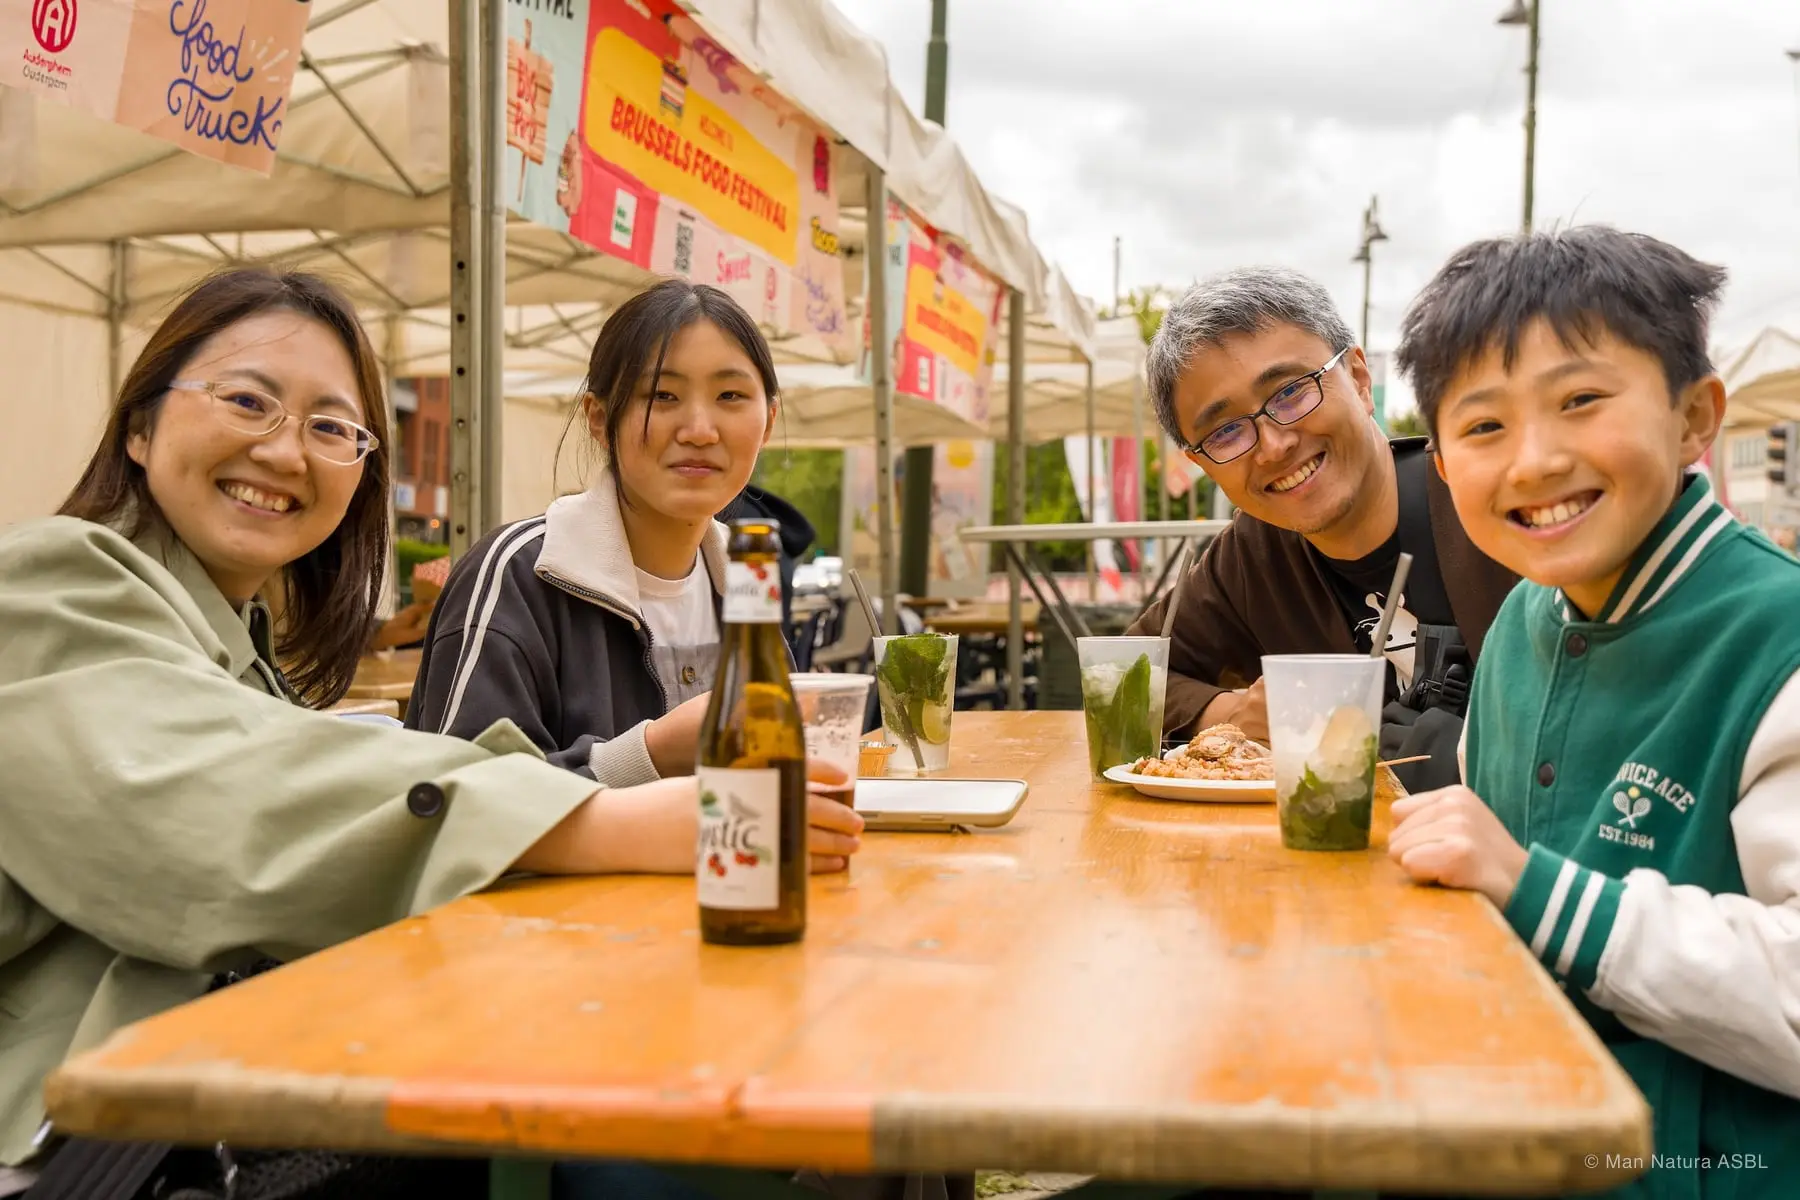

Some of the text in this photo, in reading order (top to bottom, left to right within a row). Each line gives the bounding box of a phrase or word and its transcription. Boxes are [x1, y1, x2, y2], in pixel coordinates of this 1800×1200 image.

[610, 96, 788, 233] BRUSSELS FOOD FESTIVAL
[1654, 777, 1695, 813] ACE
